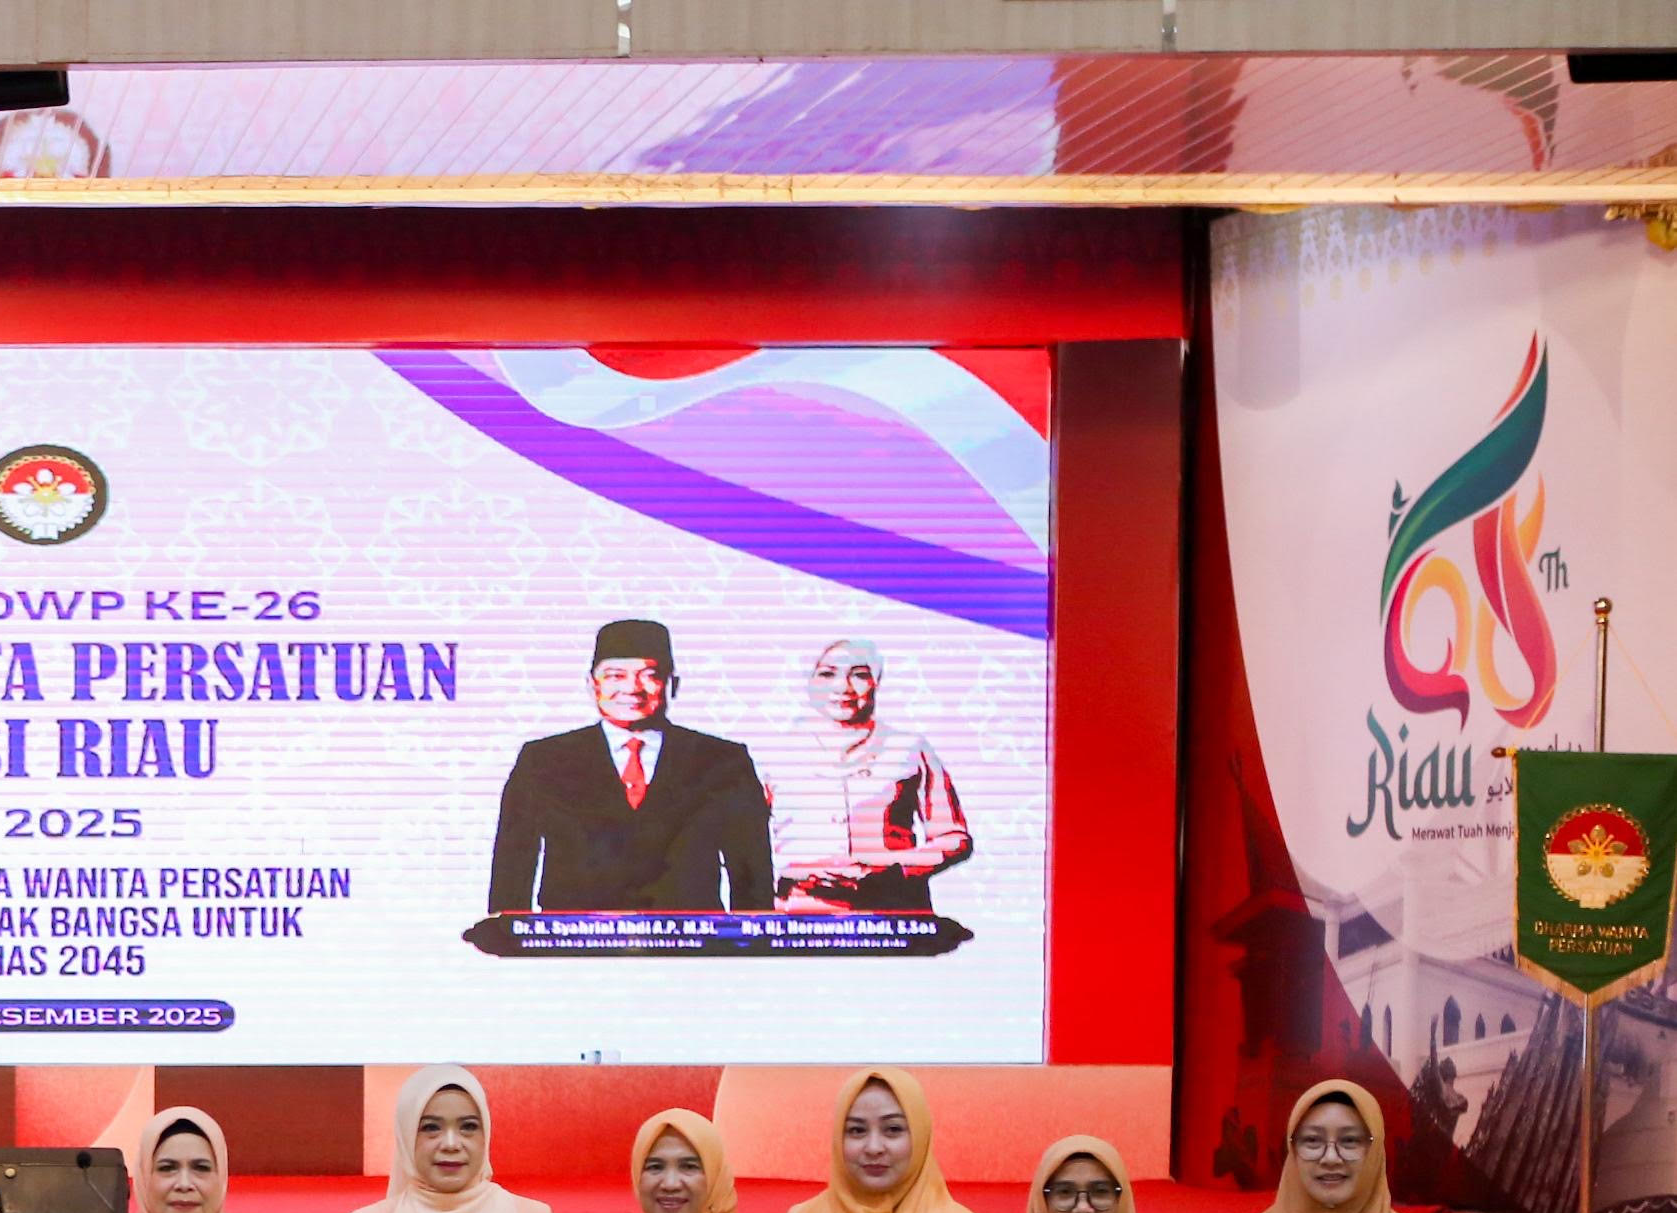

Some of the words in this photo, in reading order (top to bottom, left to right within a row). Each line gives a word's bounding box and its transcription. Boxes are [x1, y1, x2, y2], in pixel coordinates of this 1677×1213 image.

[1539, 546, 1569, 592] Th
[145, 590, 321, 621] KE-26
[71, 641, 458, 702] PERSATUAN
[56, 718, 219, 779] RIAU
[1346, 704, 1475, 841] Riau
[5, 808, 142, 838] 2025
[1412, 826, 1454, 840] Merawat
[1458, 824, 1482, 838] Tuah
[23, 867, 149, 899] WANITA
[159, 867, 350, 899] PERSATUAN
[50, 906, 182, 938] BANGSA
[192, 906, 303, 938] UNTUK
[1535, 920, 1593, 937] DHARMA
[1598, 925, 1649, 939] WANITA
[59, 945, 145, 976] 2045
[1549, 938, 1632, 955] PERSATUAN
[148, 1007, 221, 1026] 2025
